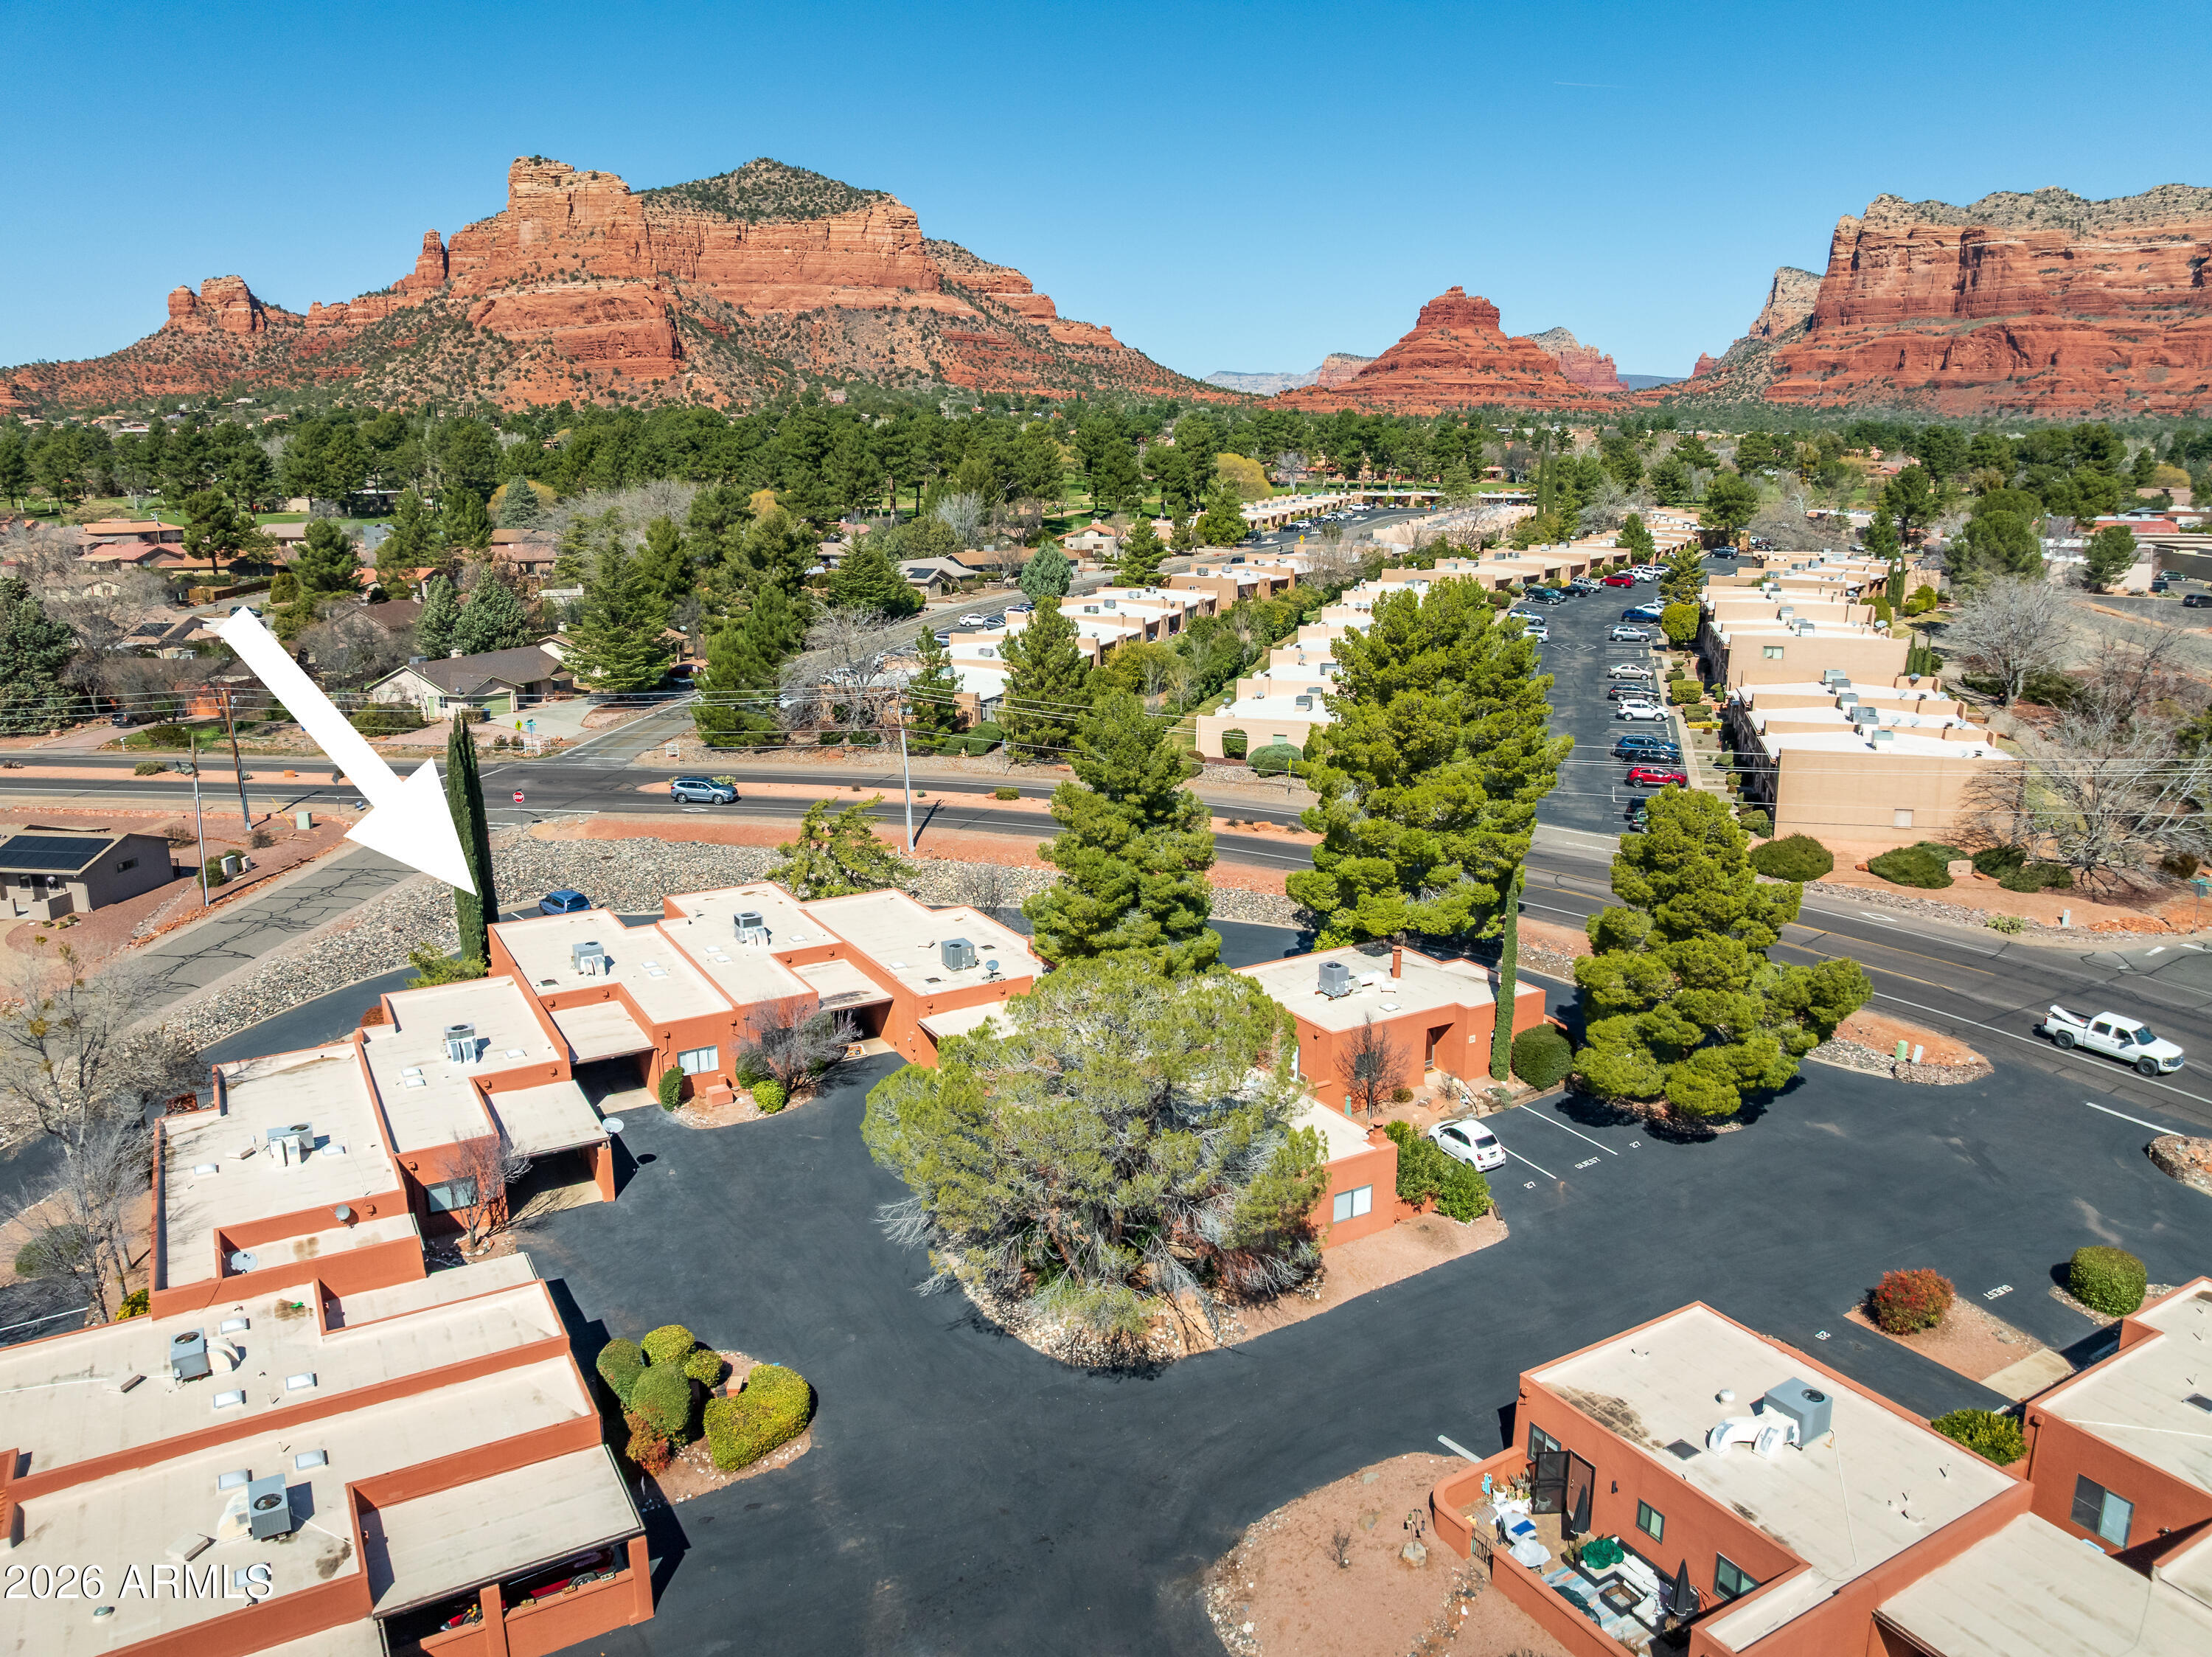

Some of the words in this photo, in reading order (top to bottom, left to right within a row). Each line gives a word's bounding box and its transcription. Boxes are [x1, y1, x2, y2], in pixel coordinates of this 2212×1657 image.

[1629, 1141, 1641, 1149] 27
[1574, 1156, 1601, 1170] GUEST
[1523, 1181, 1537, 1189] 27
[1983, 1285, 2014, 1300] GUEST
